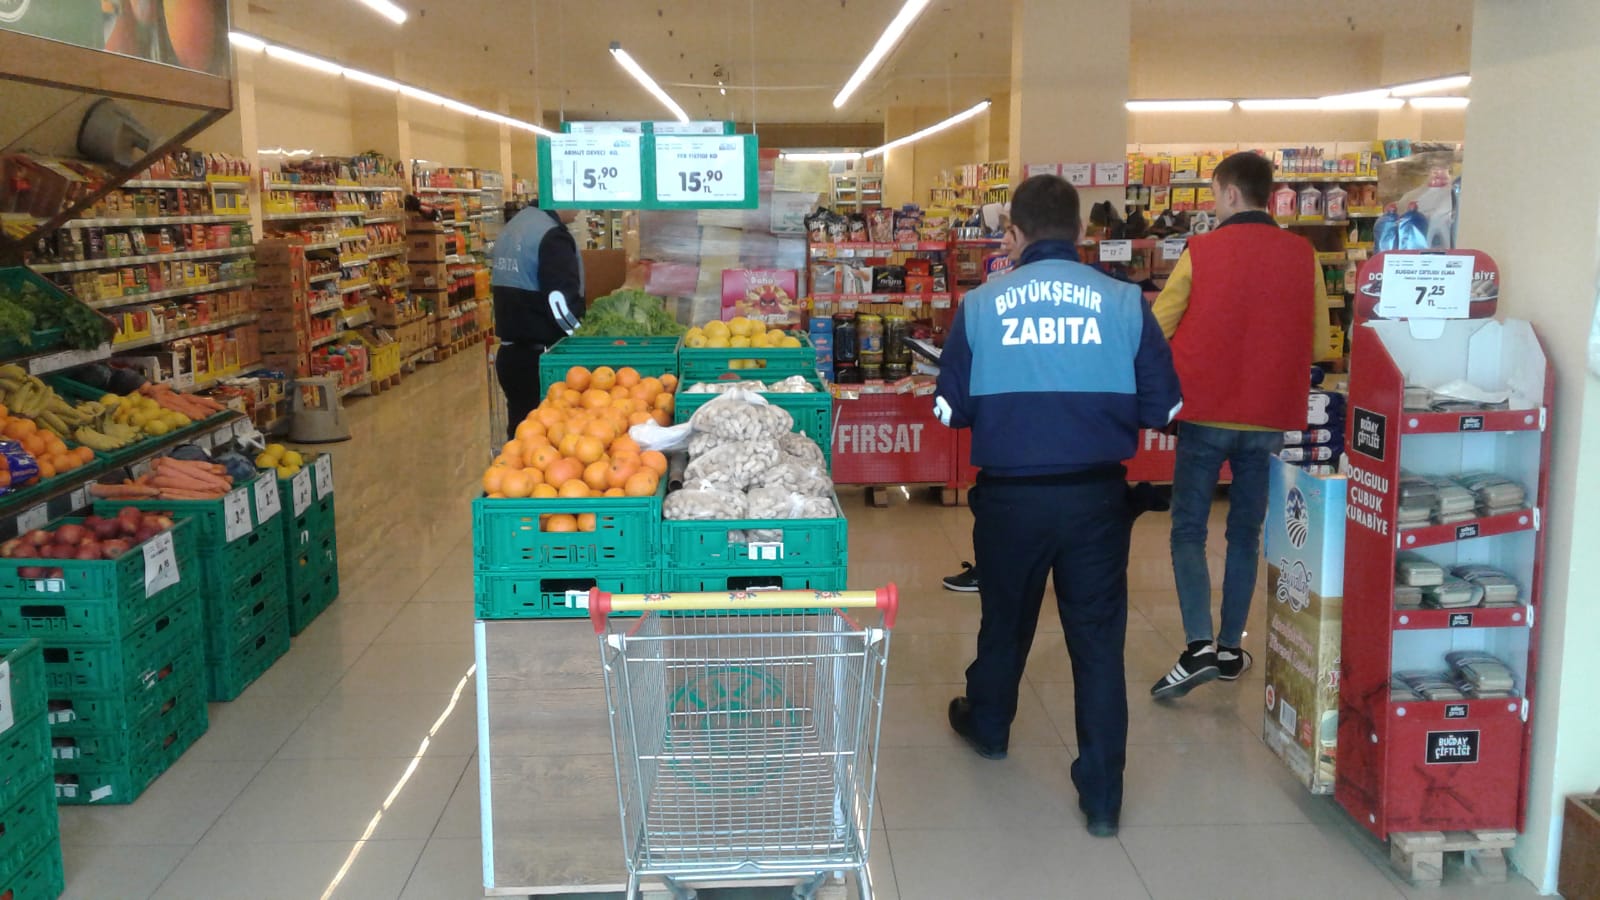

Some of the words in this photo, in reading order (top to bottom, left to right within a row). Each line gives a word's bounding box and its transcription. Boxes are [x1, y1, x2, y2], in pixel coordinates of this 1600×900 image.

[994, 279, 1102, 316] BÜYÜKŞEHİR
[1427, 299, 1436, 307] TL
[1001, 317, 1103, 346] ZABITA
[838, 423, 925, 454] FIRSAT
[1347, 463, 1389, 494] DOLGULU
[1350, 486, 1383, 513] ÇUBUK
